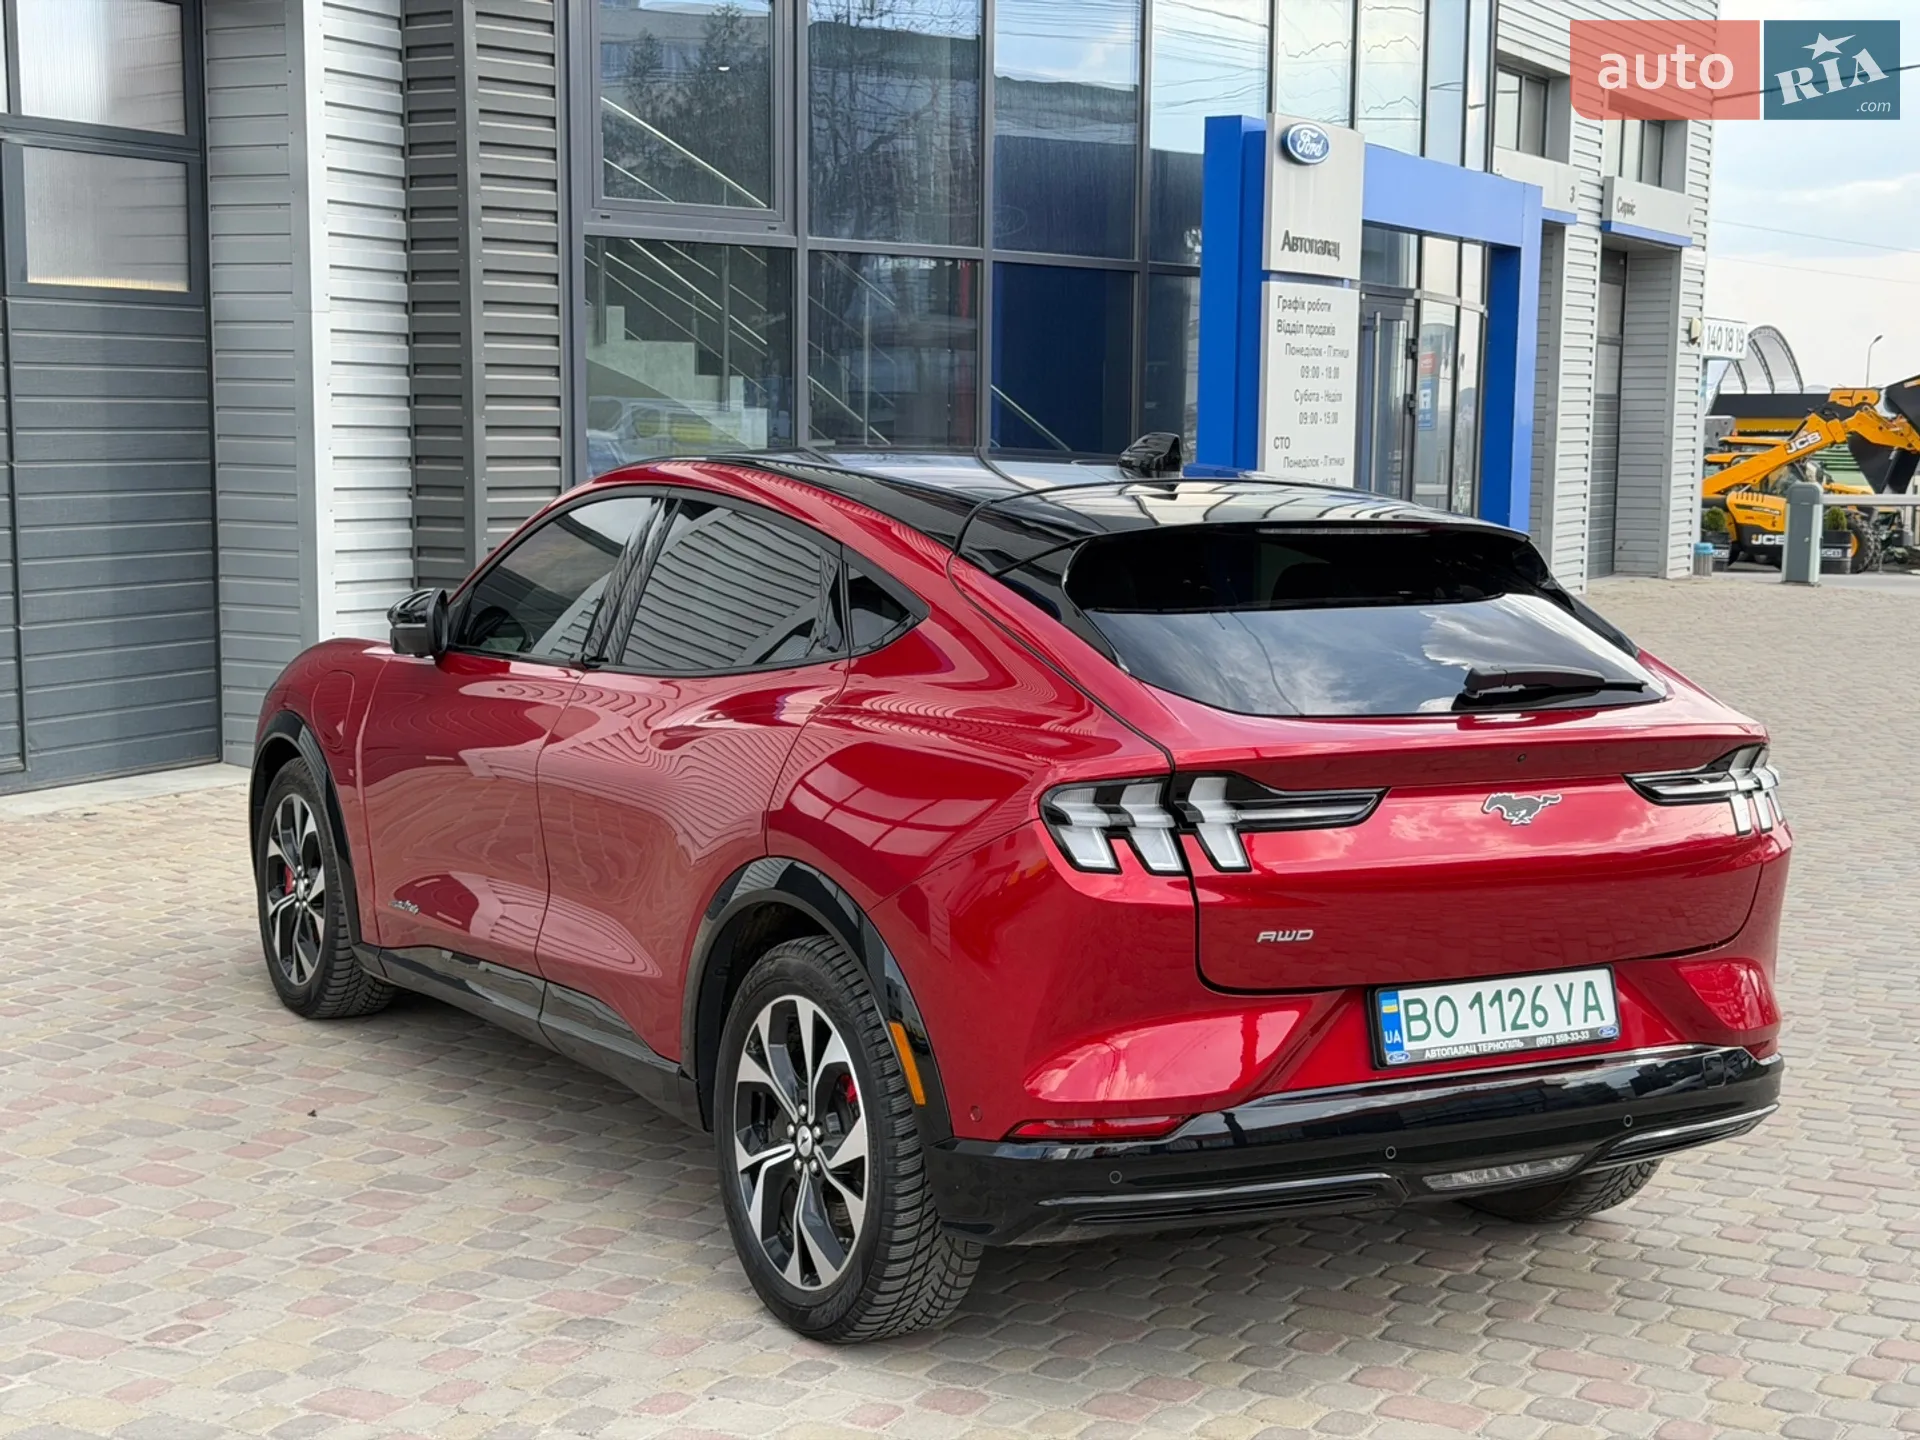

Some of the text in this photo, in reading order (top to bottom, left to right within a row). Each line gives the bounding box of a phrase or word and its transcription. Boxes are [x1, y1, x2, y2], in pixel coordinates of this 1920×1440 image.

[1295, 128, 1325, 158] Ford
[1569, 186, 1576, 203] 3
[1281, 230, 1340, 261] Автопалац
[1277, 295, 1331, 314] Графік роботи
[1277, 319, 1335, 338] Відділ продажів
[1300, 365, 1319, 378] 09:00
[1294, 389, 1319, 405] Субота
[1299, 412, 1318, 425] 09:00
[1274, 436, 1290, 449] СТО
[1787, 432, 1822, 453] JCB
[1257, 929, 1314, 943] AWD
[1403, 980, 1605, 1042] BO 1126 YA
[1384, 1029, 1402, 1044] UA
[1425, 1039, 1524, 1059] АВТОПАЛАЦ ТЕРНОПІЛЬ
